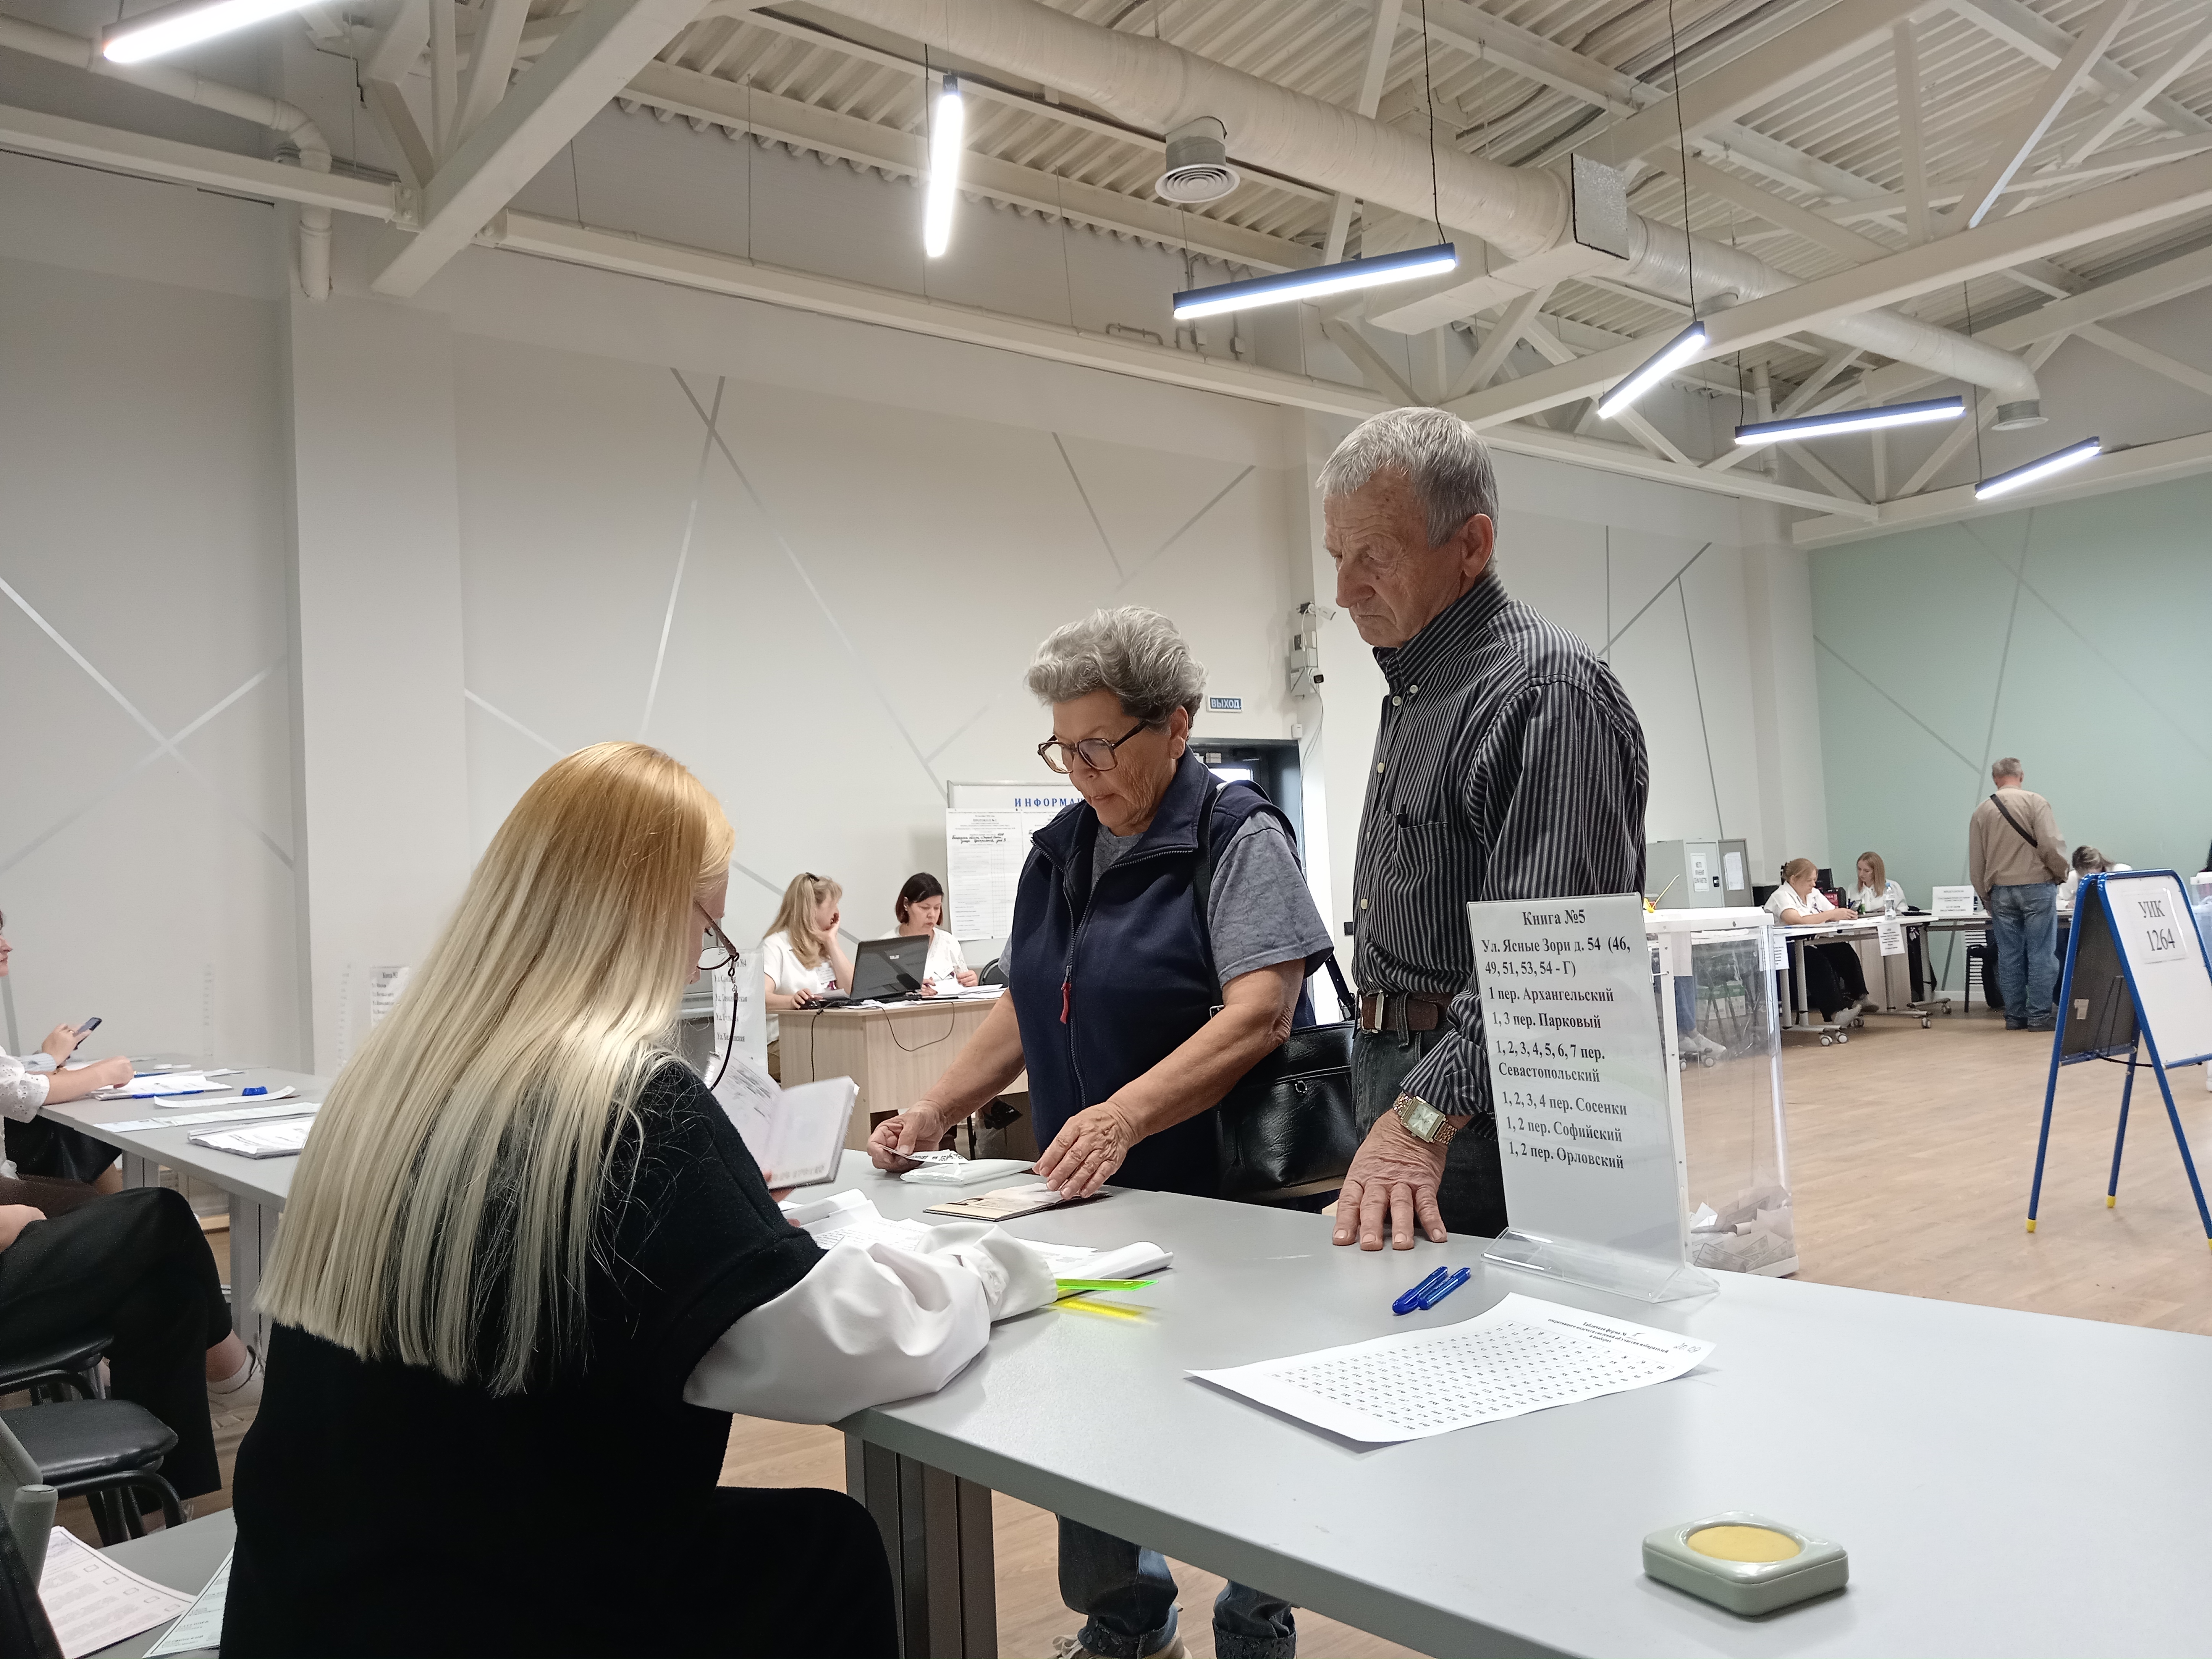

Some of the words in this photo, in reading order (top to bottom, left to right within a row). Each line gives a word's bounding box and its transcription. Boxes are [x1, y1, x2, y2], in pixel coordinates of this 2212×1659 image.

[1211, 699, 1240, 709] ВЫХОД
[1523, 911, 1562, 926] Книга
[1564, 909, 1586, 924] №5
[1481, 939, 1500, 952] Ул.
[1503, 939, 1540, 952] Ясные
[1542, 938, 1571, 955] Зори
[1574, 941, 1585, 953] д.
[1587, 936, 1601, 951] 54
[1608, 936, 1631, 954] (46,
[2147, 928, 2175, 951] 1264
[1539, 960, 1553, 975] 54
[1562, 961, 1576, 978] Г)
[1488, 986, 1495, 999] 1
[1497, 990, 1520, 1004] пер.
[1523, 987, 1614, 1004] Архангельский
[1503, 1012, 1510, 1025] 3
[1513, 1015, 1536, 1029] пер.
[1538, 1012, 1601, 1031] Парковый
[1570, 1044, 1576, 1058] 7
[1580, 1048, 1605, 1063] пер.
[1499, 1062, 1600, 1082] Севастопольский
[1539, 1094, 1546, 1108] 4
[1549, 1098, 1573, 1113] пер.
[1575, 1097, 1627, 1116] Сосенки
[1518, 1117, 1525, 1130] 2
[1527, 1122, 1551, 1137] пер.
[1553, 1121, 1623, 1142] Софийский
[1520, 1142, 1527, 1156] 2
[1530, 1147, 1554, 1163] пер.
[1556, 1147, 1624, 1169] Орловский
